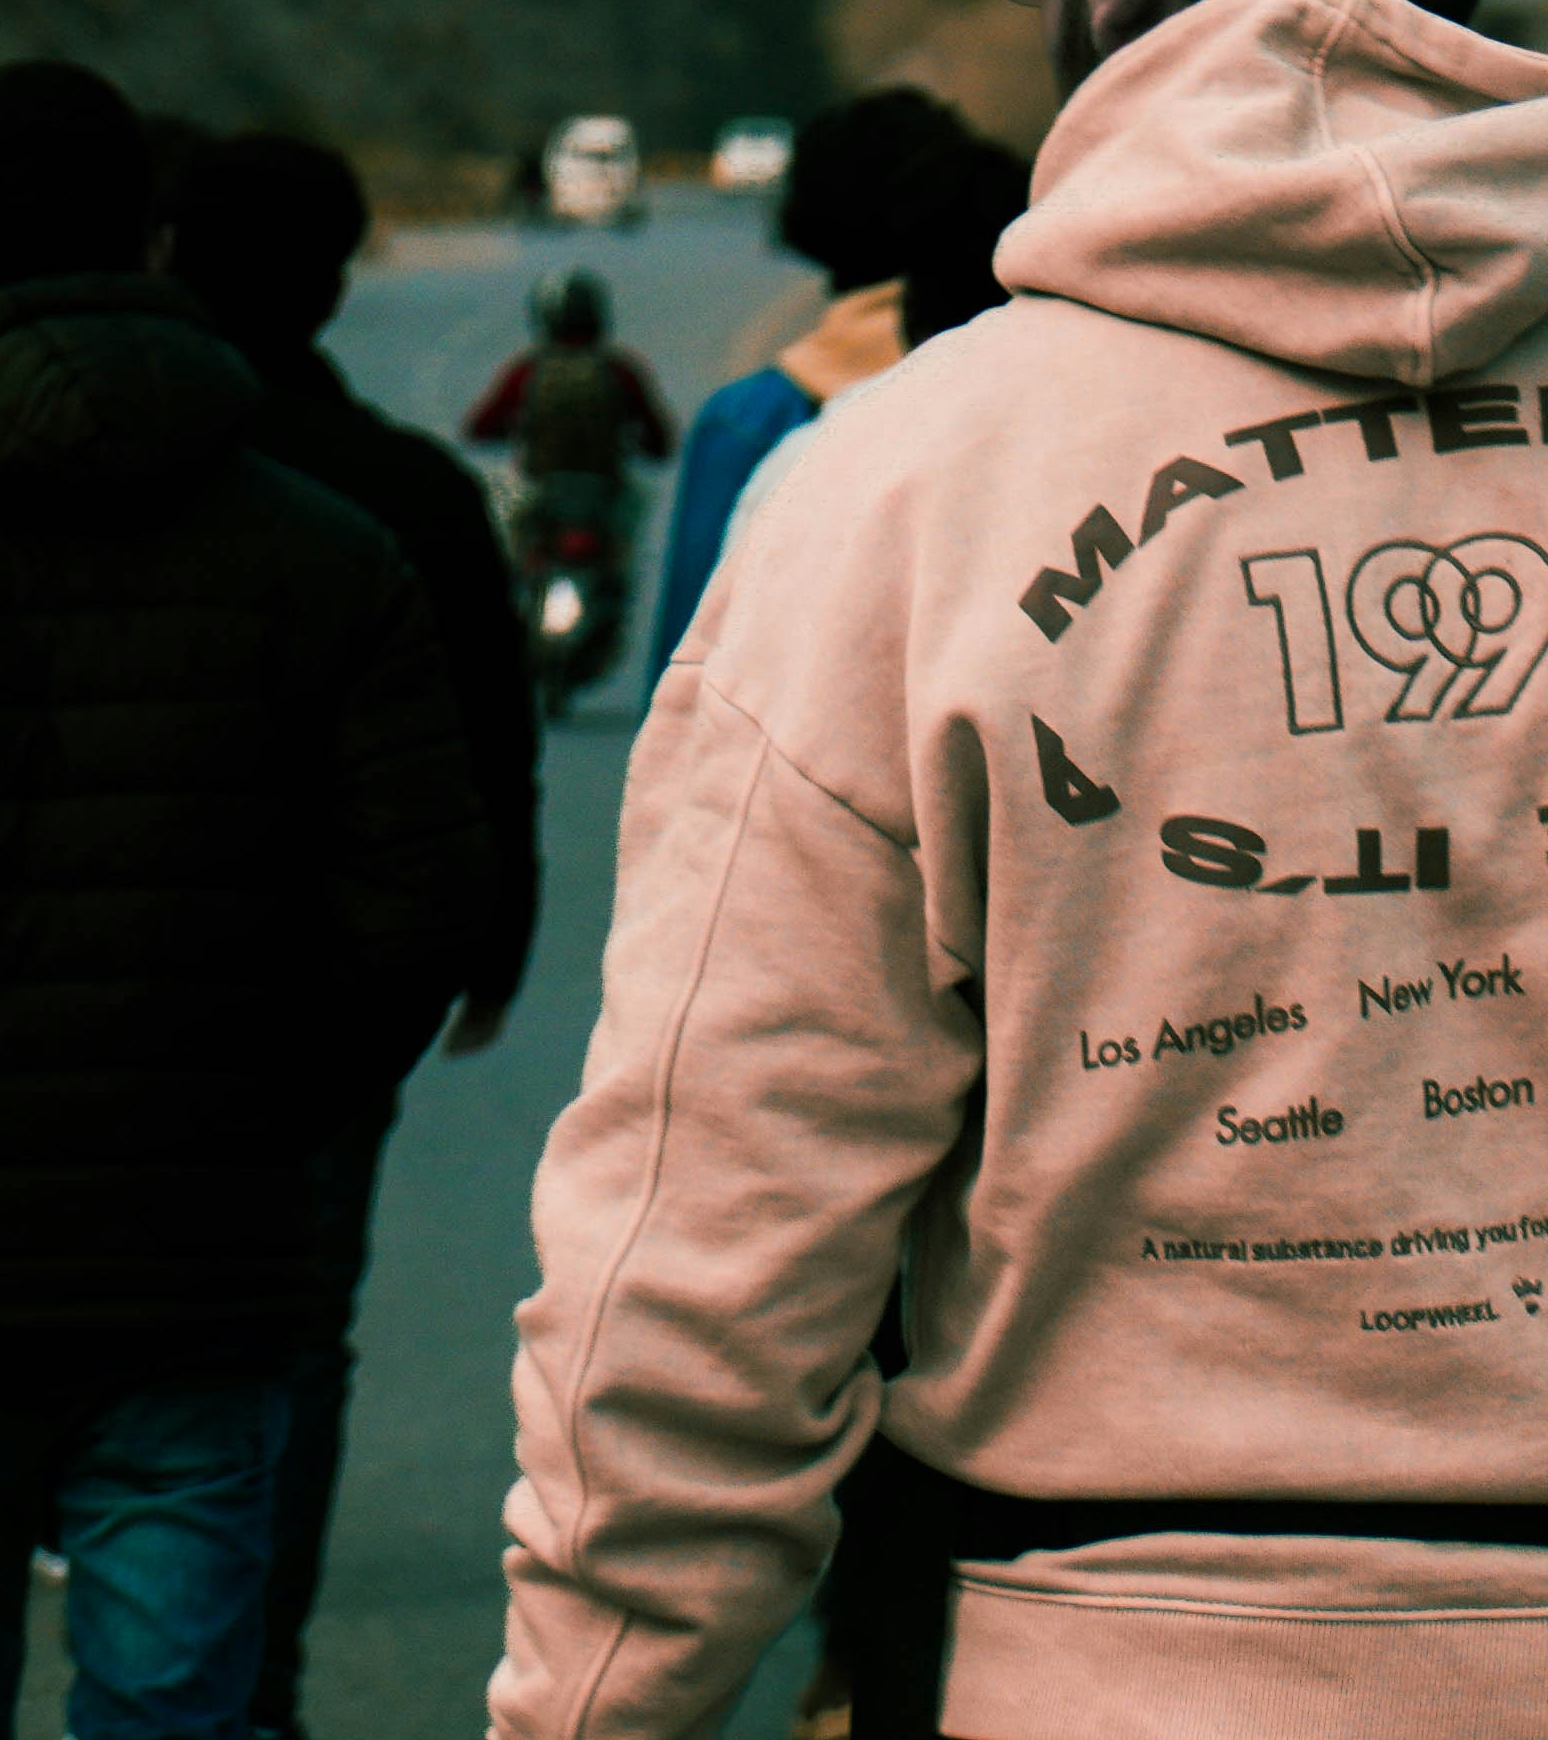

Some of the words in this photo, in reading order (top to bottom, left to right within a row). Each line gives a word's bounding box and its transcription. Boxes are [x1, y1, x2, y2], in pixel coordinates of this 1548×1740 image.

[1030, 713, 1123, 827] A
[1080, 1031, 1141, 1070] Los
[1153, 993, 1308, 1059] Angeles
[1358, 974, 1433, 1019] New
[1437, 952, 1525, 1002] York
[1215, 1096, 1345, 1147] Seattle
[1421, 1075, 1535, 1120] Boston
[1141, 1236, 1158, 1260] A
[1163, 1237, 1247, 1261] natural
[1252, 1237, 1384, 1261] substance
[1390, 1226, 1471, 1259] driving
[1474, 1221, 1518, 1252] you
[1360, 1299, 1500, 1332] LOOPWHEEL
